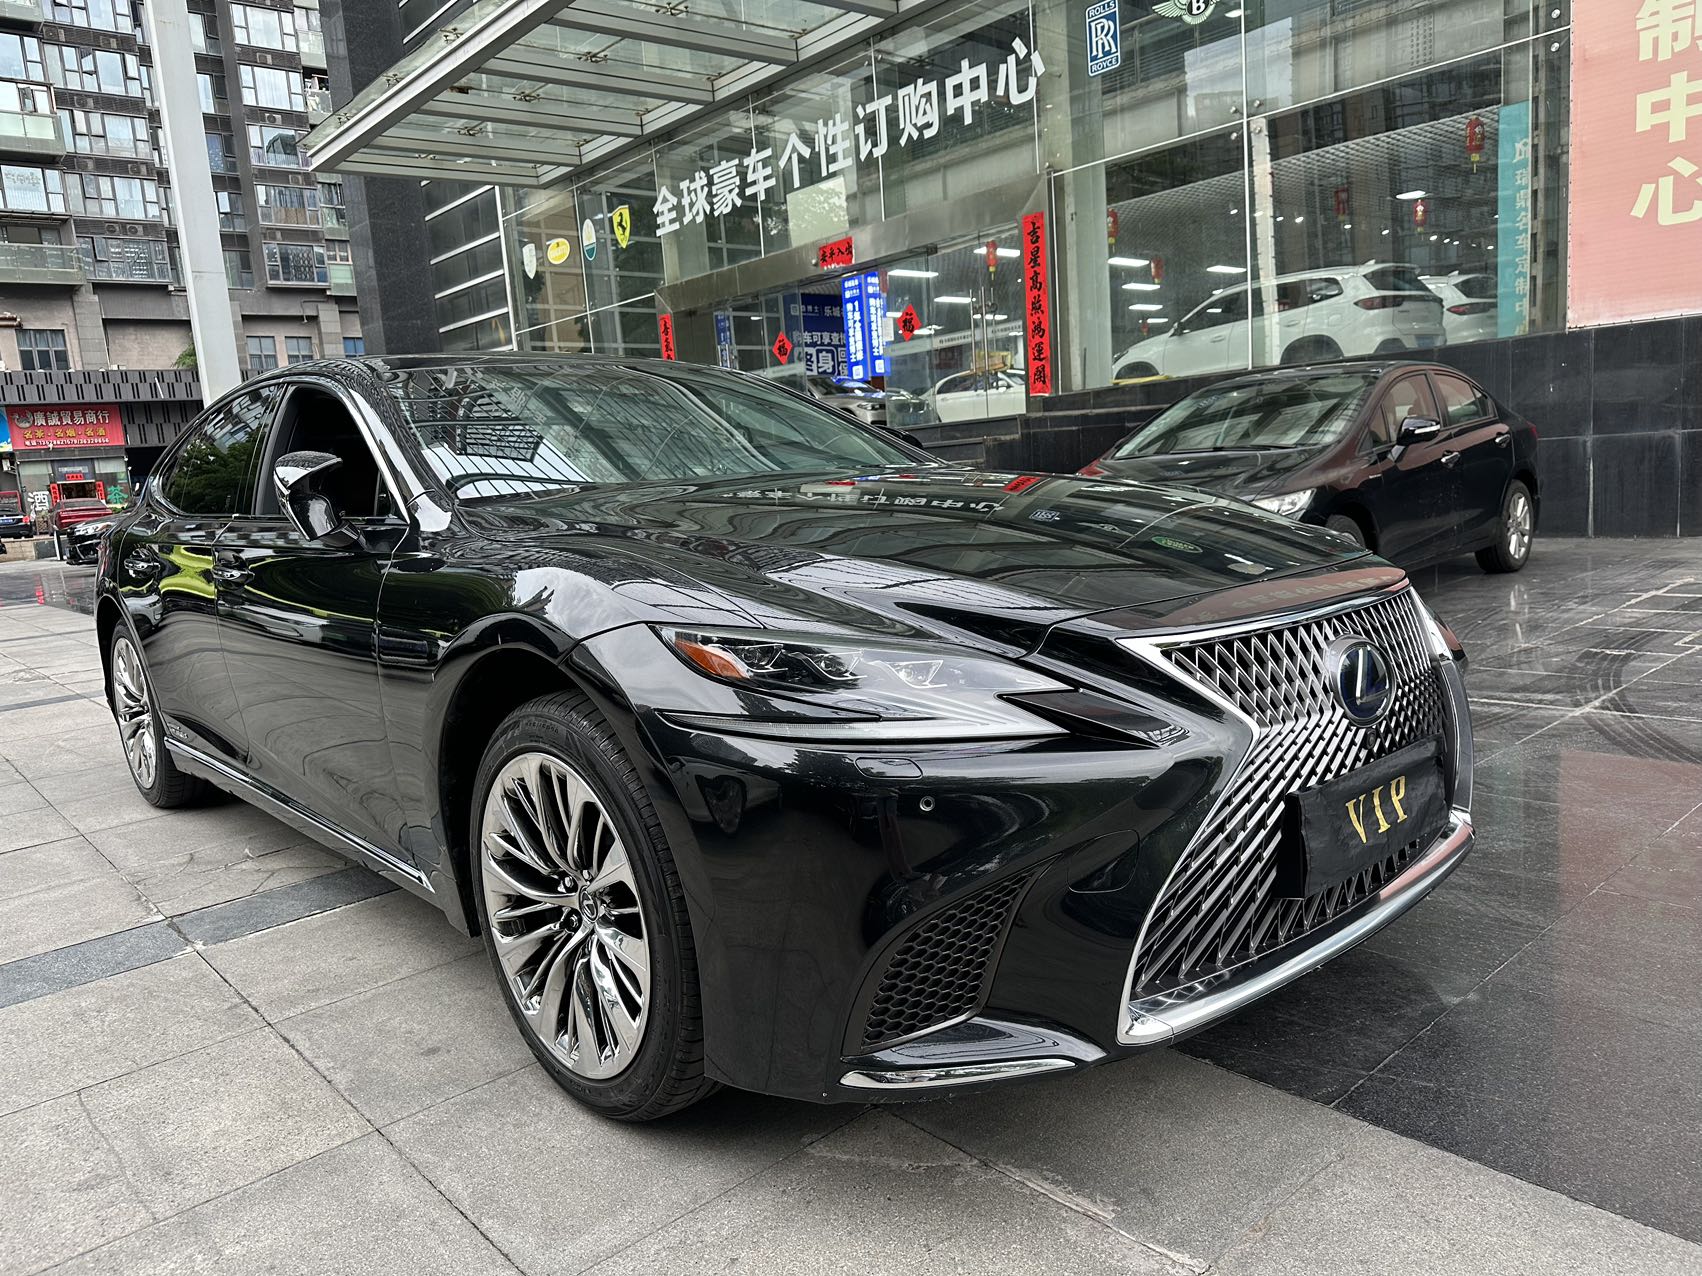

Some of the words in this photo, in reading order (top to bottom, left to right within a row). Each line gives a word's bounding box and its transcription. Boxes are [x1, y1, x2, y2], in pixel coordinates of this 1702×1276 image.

[1089, 0, 1115, 18] ROLLS
[1091, 56, 1118, 73] ROYCE
[652, 36, 1047, 238] 全球豪车个性订购中心
[107, 485, 128, 504] 茶
[1345, 775, 1408, 845] VIP
